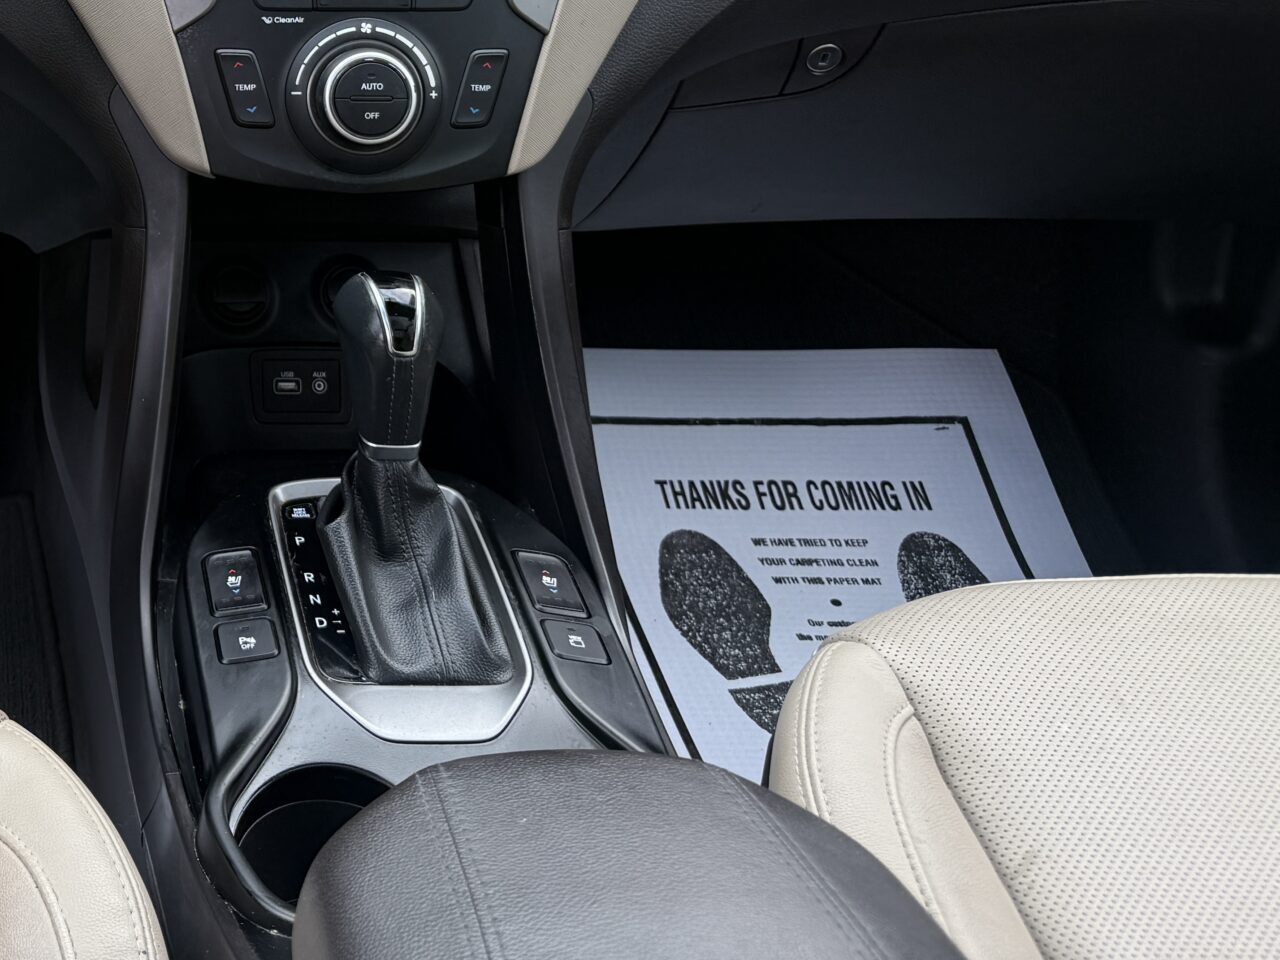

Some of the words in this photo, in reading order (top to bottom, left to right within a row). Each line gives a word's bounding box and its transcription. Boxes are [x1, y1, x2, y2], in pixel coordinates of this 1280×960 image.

[654, 479, 751, 511] THANKS
[752, 480, 804, 511] FOR
[806, 480, 902, 511] COMING
[902, 480, 933, 511] IN
[295, 536, 305, 546] P
[751, 538, 768, 546] WE
[769, 538, 796, 547] HAVE
[796, 538, 826, 547] TRIED
[828, 539, 841, 547] TO
[845, 539, 868, 547] KEEP
[757, 557, 787, 566] YOUR
[789, 558, 844, 567] CARPETING
[304, 572, 314, 582] R
[771, 576, 799, 584] WITH
[800, 577, 825, 585] THIS
[826, 577, 859, 585] PAPER
[309, 594, 322, 605] N
[315, 617, 327, 628] D
